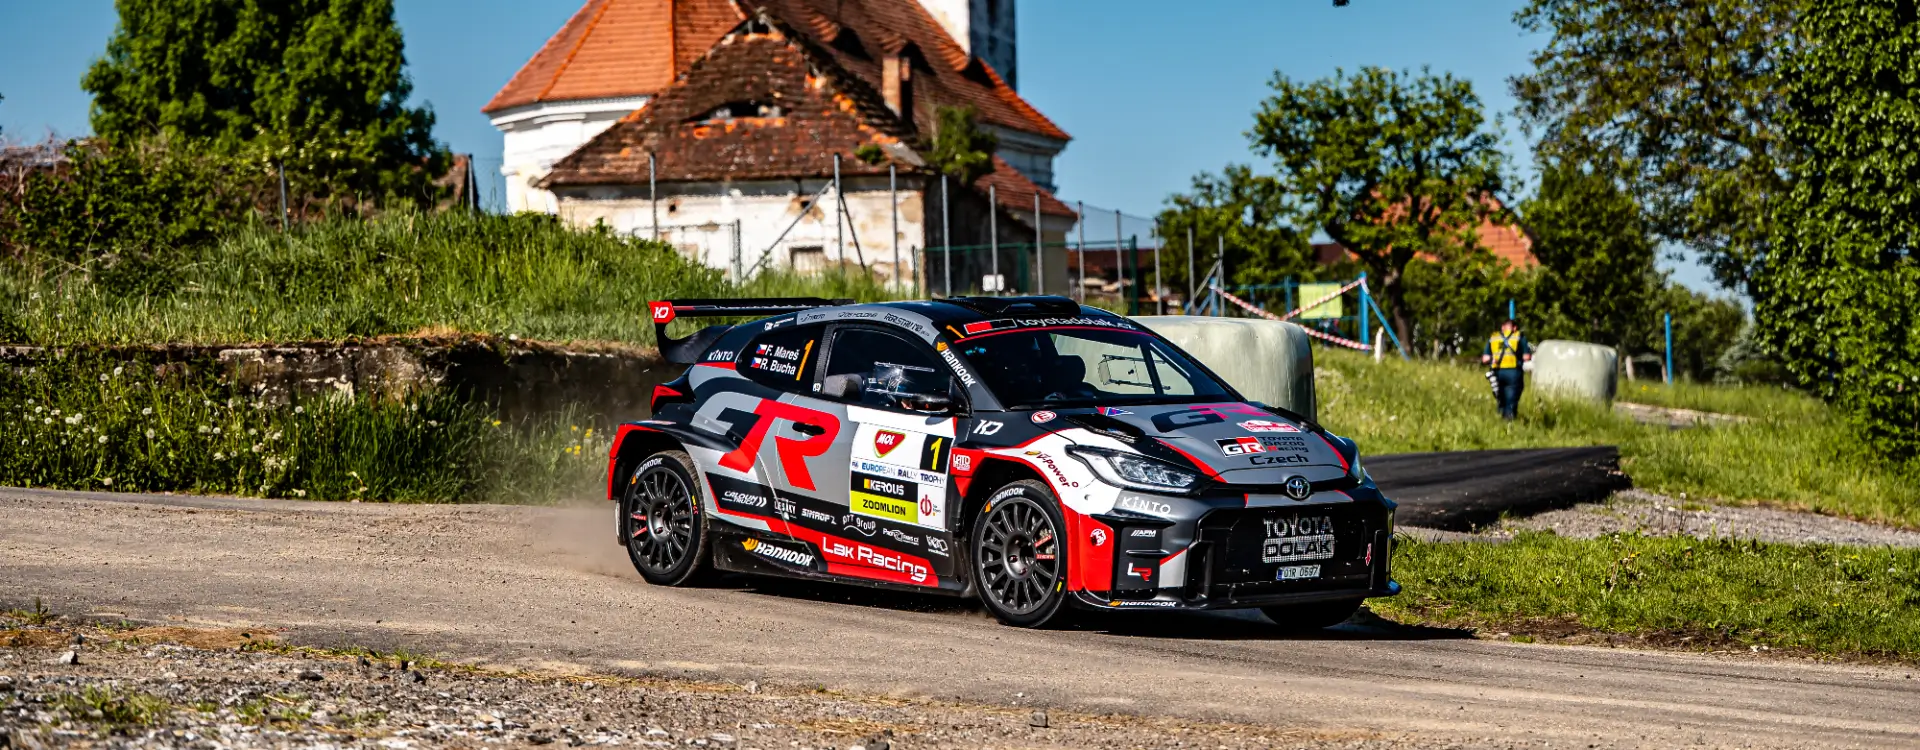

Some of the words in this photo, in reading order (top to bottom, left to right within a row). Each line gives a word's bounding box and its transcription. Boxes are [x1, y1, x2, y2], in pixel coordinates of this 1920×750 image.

[765, 344, 774, 357] F.
[774, 346, 800, 361] Mareš
[796, 339, 815, 381] 1
[760, 358, 769, 371] R.
[770, 359, 797, 376] Bucha
[876, 433, 896, 446] MOL
[1222, 442, 1261, 455] GR
[930, 437, 944, 471] 1
[1249, 453, 1309, 465] Czech
[861, 462, 896, 476] EUROPEAN
[897, 468, 918, 480] RALLY
[920, 473, 946, 484] TROPHY
[862, 498, 906, 516] ZOOMLION
[856, 517, 877, 530] group
[1262, 515, 1334, 538] TOYOTA
[1265, 540, 1333, 558] DOLAK
[822, 536, 855, 559] Lak
[858, 544, 928, 583] Racing
